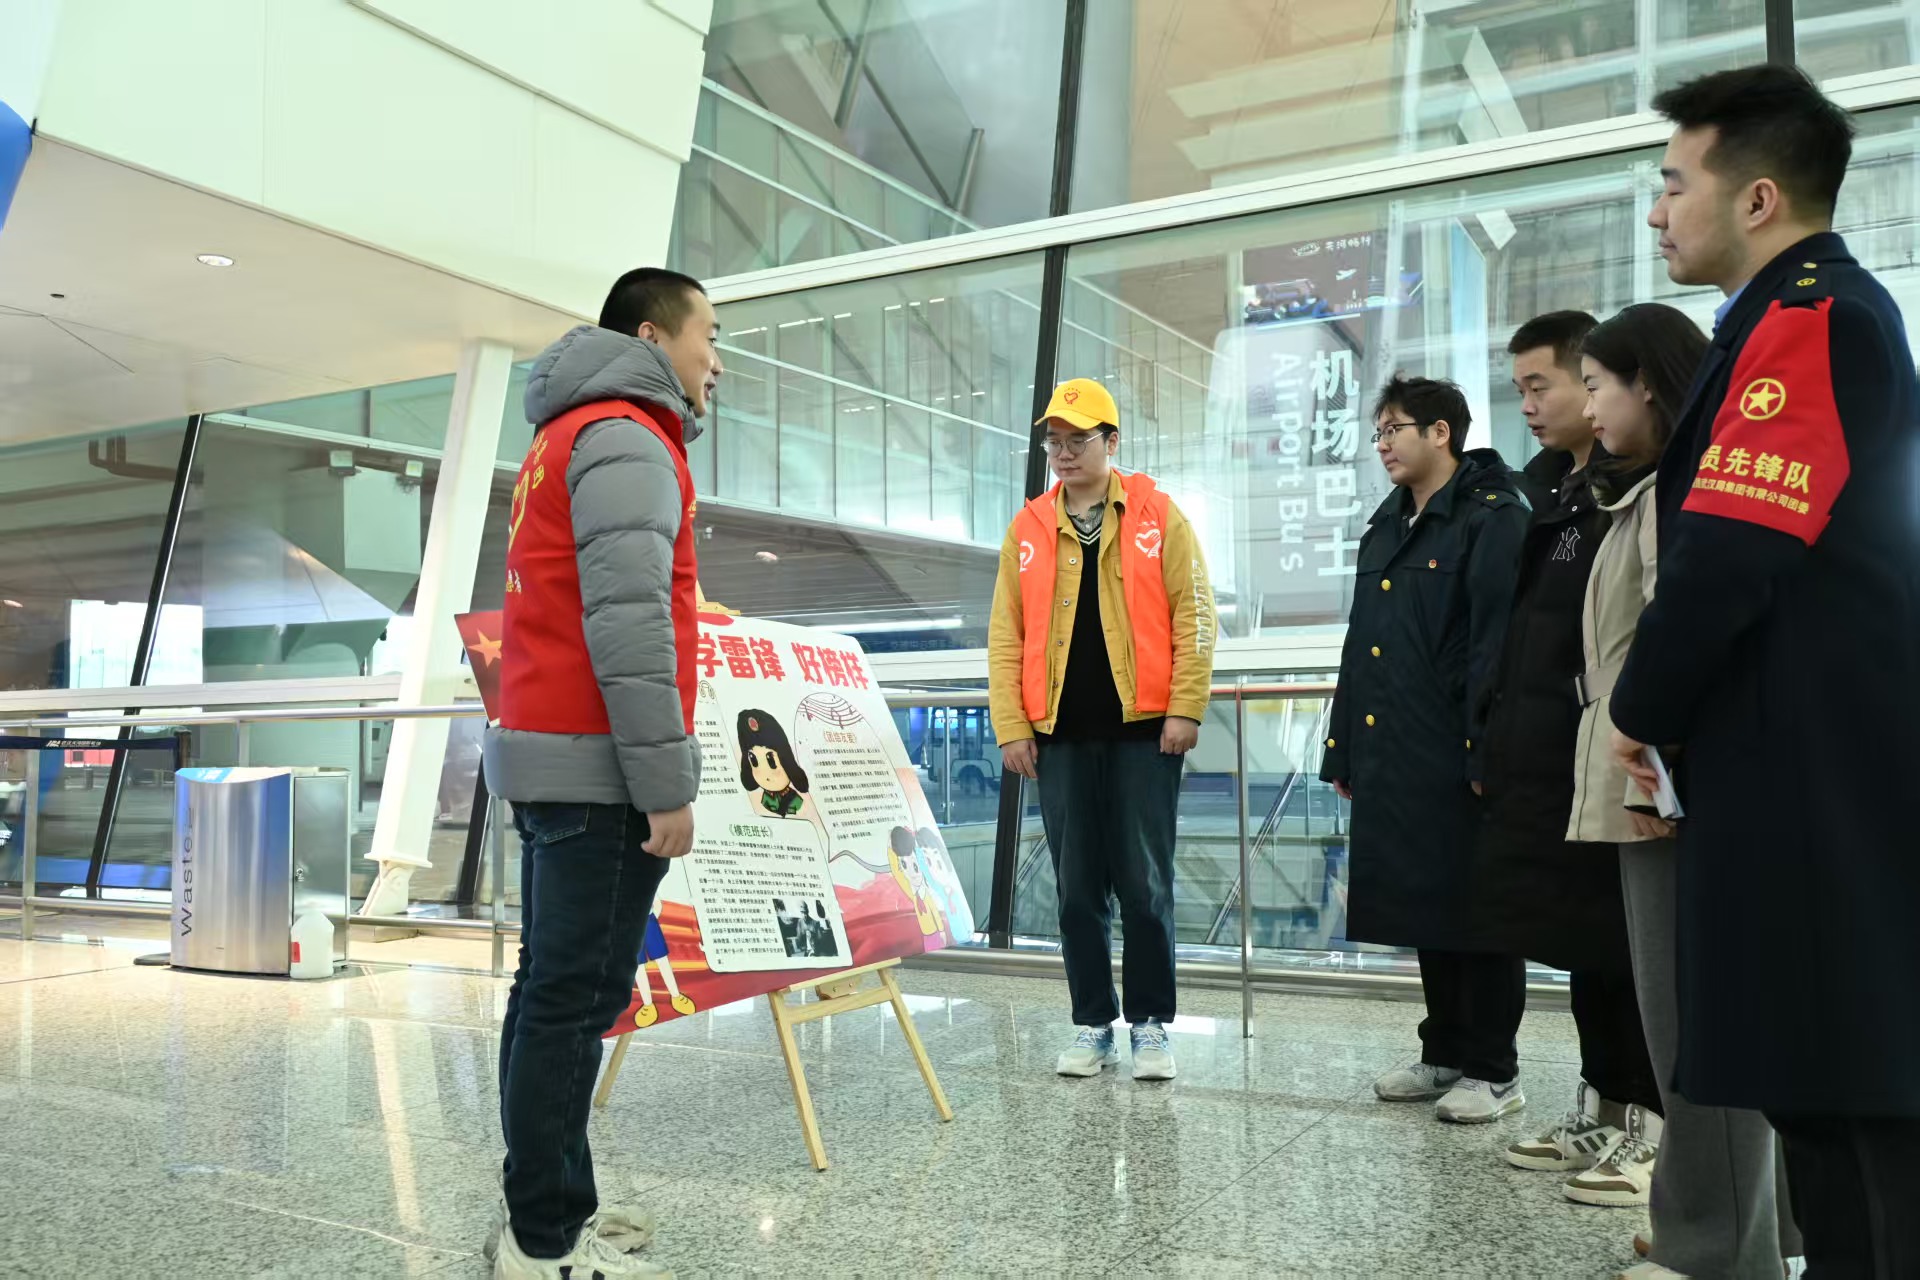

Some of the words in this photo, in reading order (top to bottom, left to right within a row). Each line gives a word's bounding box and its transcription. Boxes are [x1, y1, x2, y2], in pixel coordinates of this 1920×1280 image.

[1272, 352, 1304, 489] Airport
[1310, 349, 1362, 577] 机场巴士
[1278, 496, 1309, 572] Bus
[790, 642, 869, 690] 好榜样
[729, 823, 773, 838] 《模范班长》
[181, 838, 193, 937] Waste
